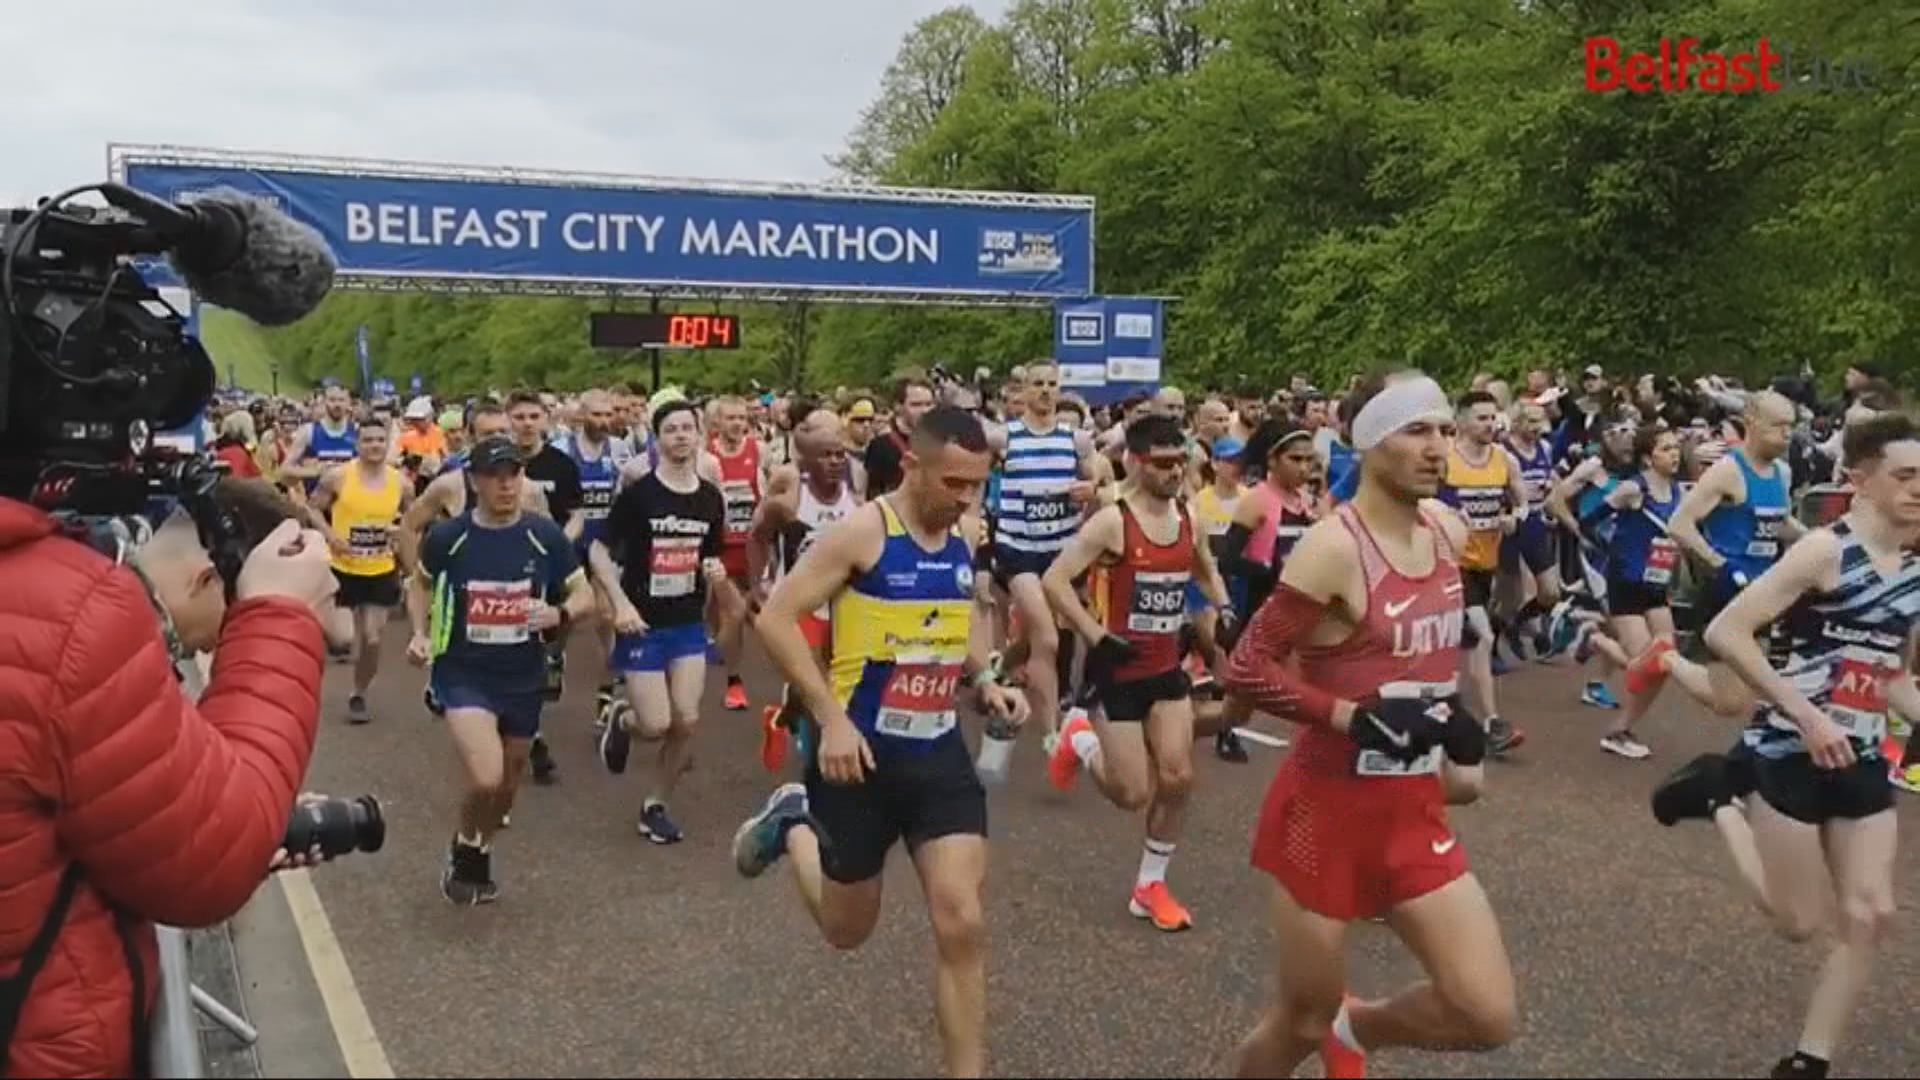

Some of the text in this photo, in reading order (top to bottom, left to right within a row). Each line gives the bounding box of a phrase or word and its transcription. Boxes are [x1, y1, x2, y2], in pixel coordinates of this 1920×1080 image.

[346, 203, 939, 265] BELFAST CITY MARATHON
[668, 315, 731, 348] 0:04
[1026, 502, 1064, 520] 2001
[1139, 590, 1185, 611] 3967
